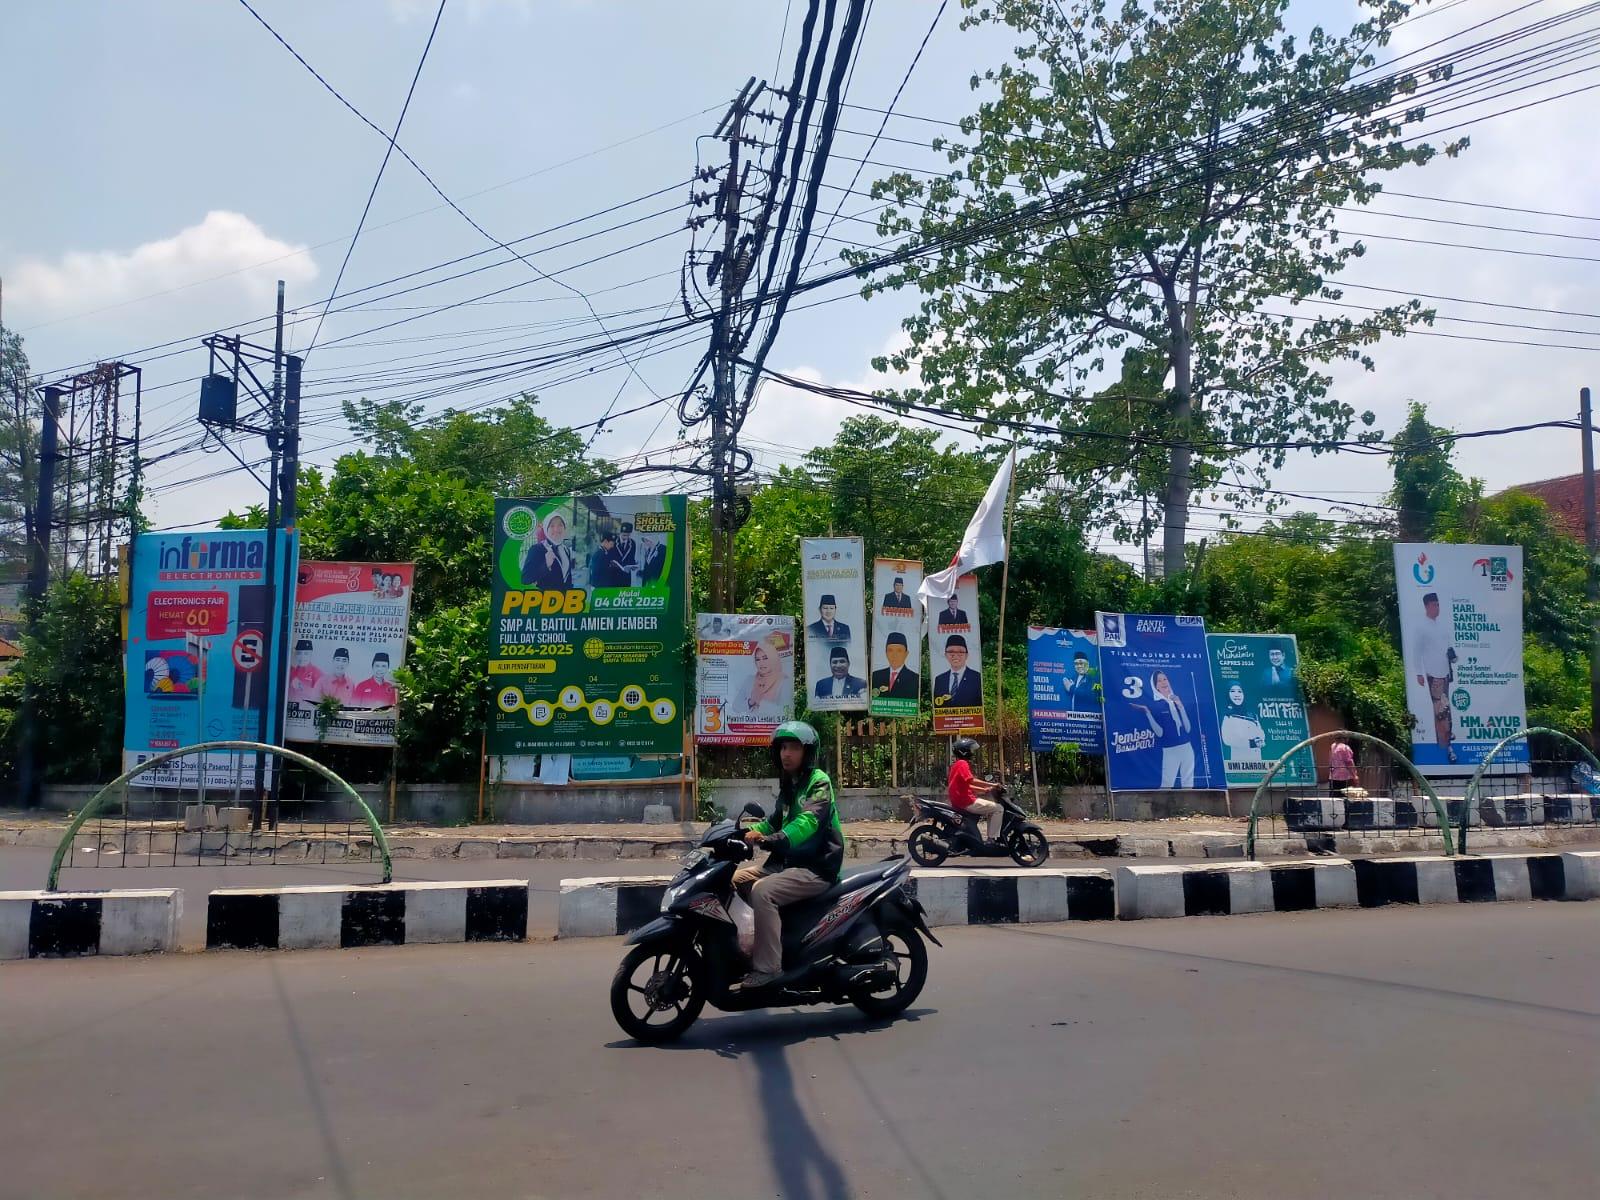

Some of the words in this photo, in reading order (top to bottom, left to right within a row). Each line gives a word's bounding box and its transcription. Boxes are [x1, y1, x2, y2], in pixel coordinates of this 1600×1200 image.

[159, 536, 264, 569] informa
[1481, 563, 1487, 577] 1
[618, 590, 640, 598] Mulai
[153, 597, 206, 606] ELECTRONICS
[207, 597, 225, 605] FAIR
[501, 590, 586, 615] PPDB
[594, 599, 610, 608] 04
[612, 597, 634, 608] Okt
[636, 597, 665, 607] 2023
[1452, 604, 1475, 613] HARI
[159, 611, 184, 619] HEMAT
[327, 614, 365, 623] SAMPAI
[370, 615, 400, 626] AKHIR
[1453, 613, 1487, 622] SANTRI
[500, 618, 523, 633] SMP
[525, 618, 539, 632] AL
[541, 617, 578, 631] BAITUL
[580, 616, 614, 631] AMIEN
[616, 616, 658, 630] JEMBER
[1136, 625, 1166, 633] RAKYAT
[1454, 622, 1501, 632] NASIONAL
[499, 633, 519, 644] FULL
[520, 633, 536, 644] DAY
[537, 632, 568, 643] SCHOOL
[1104, 632, 1120, 640] PAN
[1454, 631, 1480, 642] (HSN)
[499, 644, 574, 656] 2024-2025
[743, 640, 750, 649] &
[1225, 639, 1248, 652] Gus
[240, 639, 258, 662] S
[1216, 647, 1255, 660] Muhaimin
[528, 676, 538, 684] 02
[650, 674, 659, 682] 06
[1122, 676, 1143, 698] 3
[557, 712, 567, 720] 03
[618, 711, 628, 719] 05
[1258, 702, 1280, 719] Idul
[704, 705, 721, 732] 3
[1460, 716, 1484, 727] HM.
[1487, 716, 1520, 727] AYUB
[1111, 728, 1155, 746] Jember
[1227, 762, 1241, 771] UMI
[1289, 760, 1297, 777] 1
